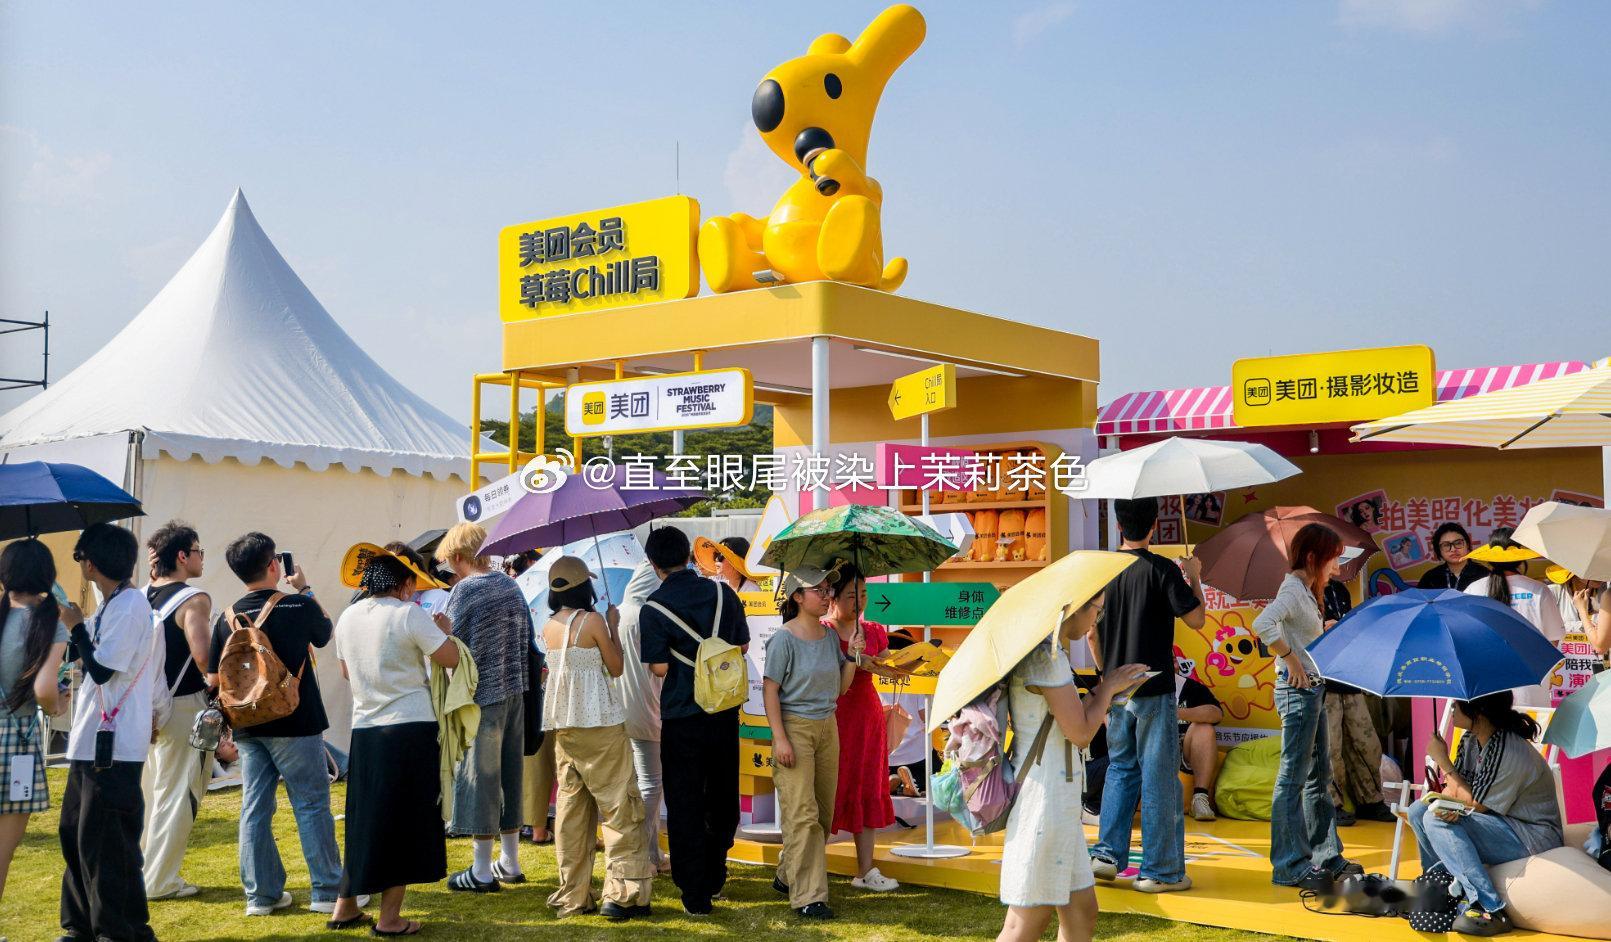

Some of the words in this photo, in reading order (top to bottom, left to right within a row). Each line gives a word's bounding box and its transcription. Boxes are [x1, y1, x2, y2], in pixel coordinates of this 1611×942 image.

[519, 217, 625, 267] 美团会员
[519, 255, 660, 308] 草莓Chill局
[667, 383, 726, 397] STRAWBERRY
[1247, 386, 1269, 398] 美团
[1276, 371, 1419, 401] 美团·摄影妆造
[610, 391, 650, 419] 美团
[683, 394, 711, 403] MUSIC
[584, 401, 604, 415] 美团
[676, 403, 717, 413] FESTIVAL
[958, 590, 985, 603] 身体
[945, 606, 985, 620] 维修点
[1561, 643, 1595, 655] 美团
[1565, 658, 1603, 671] 陪我
